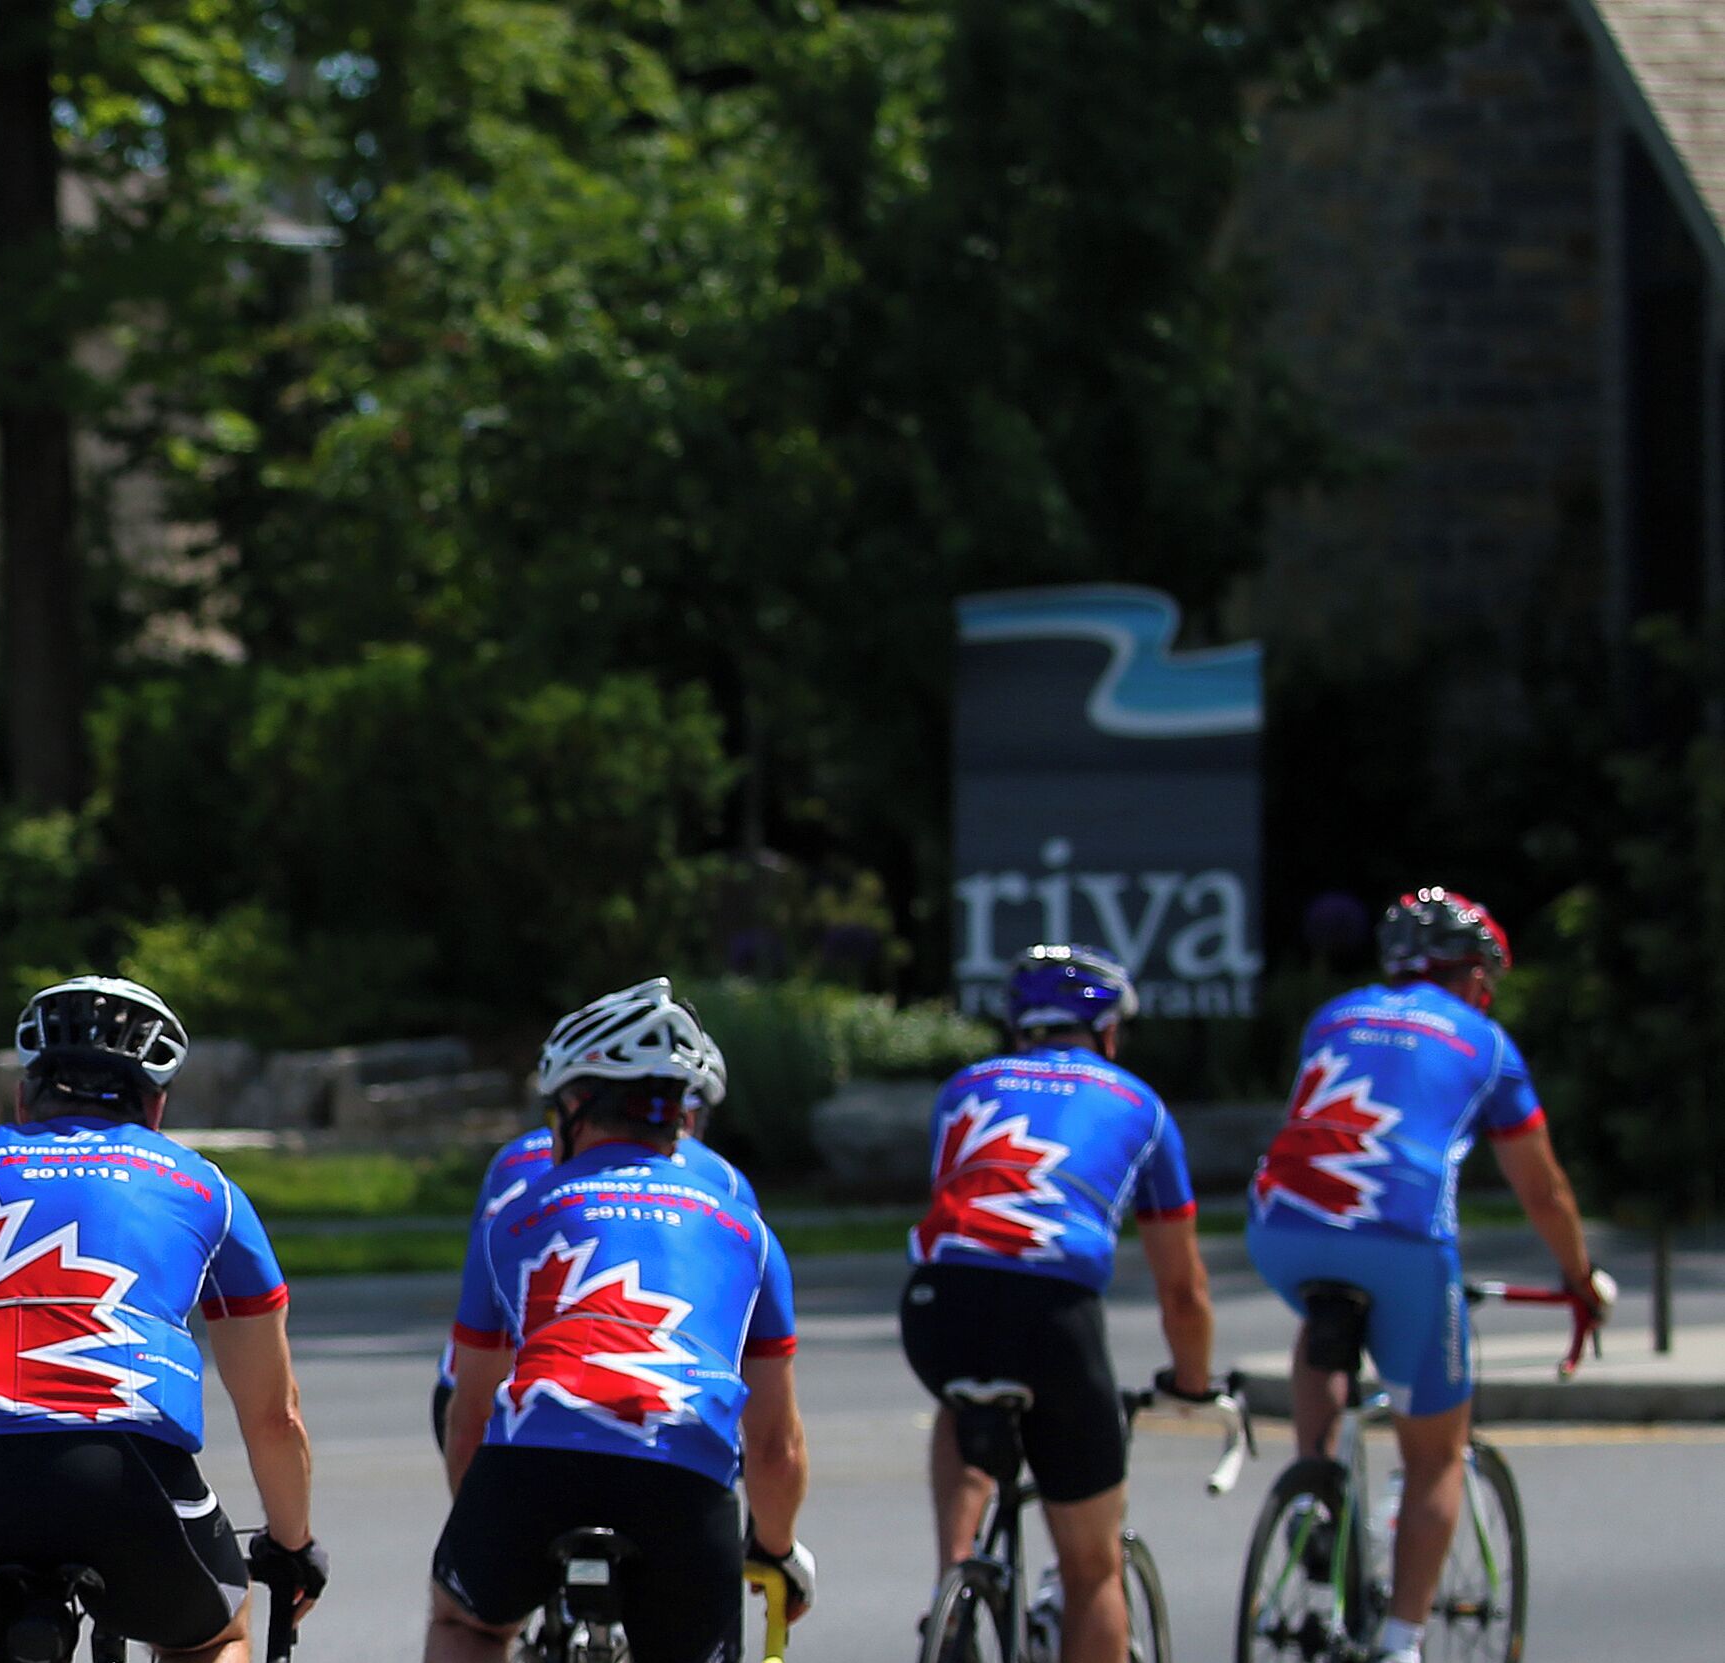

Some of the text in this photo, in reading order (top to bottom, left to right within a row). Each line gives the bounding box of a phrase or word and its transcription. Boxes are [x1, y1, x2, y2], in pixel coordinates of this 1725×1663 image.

[956, 837, 1264, 982] riva
[21, 1166, 131, 1183] 2011-12
[42, 1153, 213, 1203] KINGSTON
